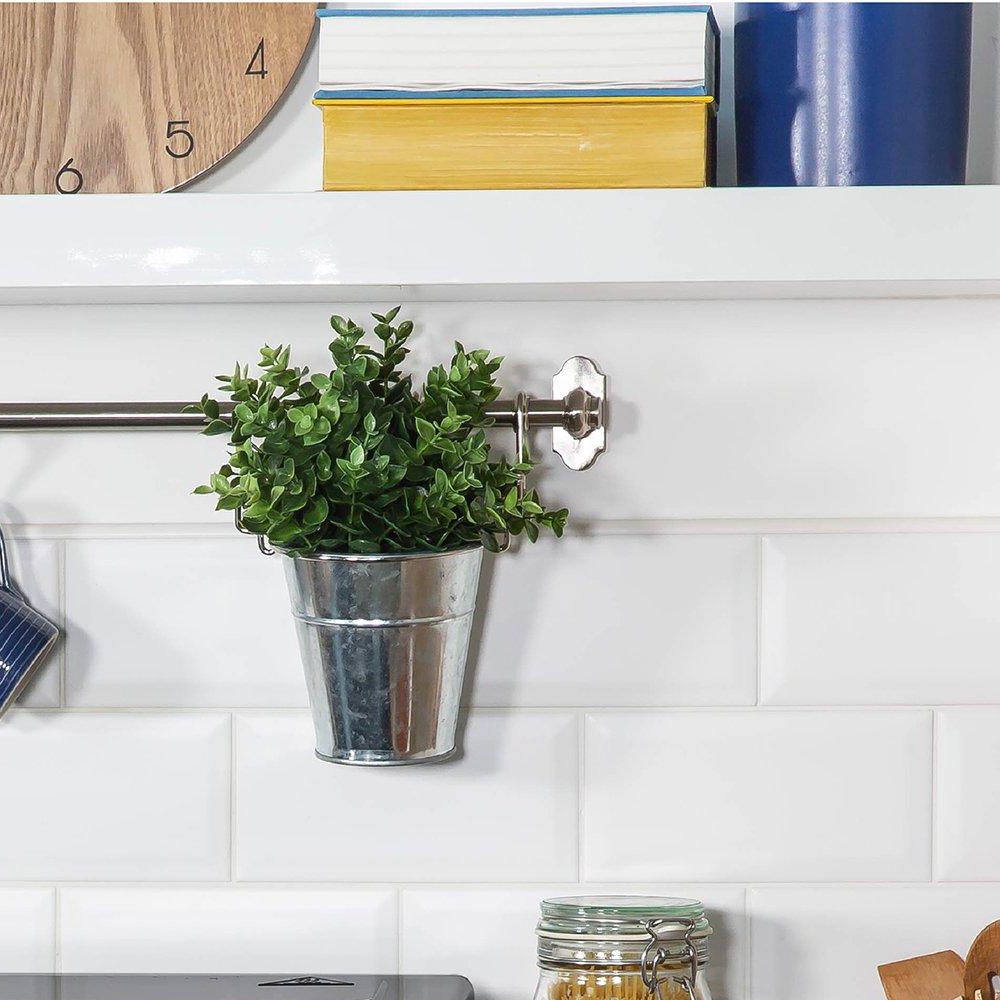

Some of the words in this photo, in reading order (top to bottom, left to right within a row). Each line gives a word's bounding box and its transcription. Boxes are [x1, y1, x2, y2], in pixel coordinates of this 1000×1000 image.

[245, 37, 268, 80] 4
[165, 120, 194, 159] 5
[55, 157, 83, 195] 6
